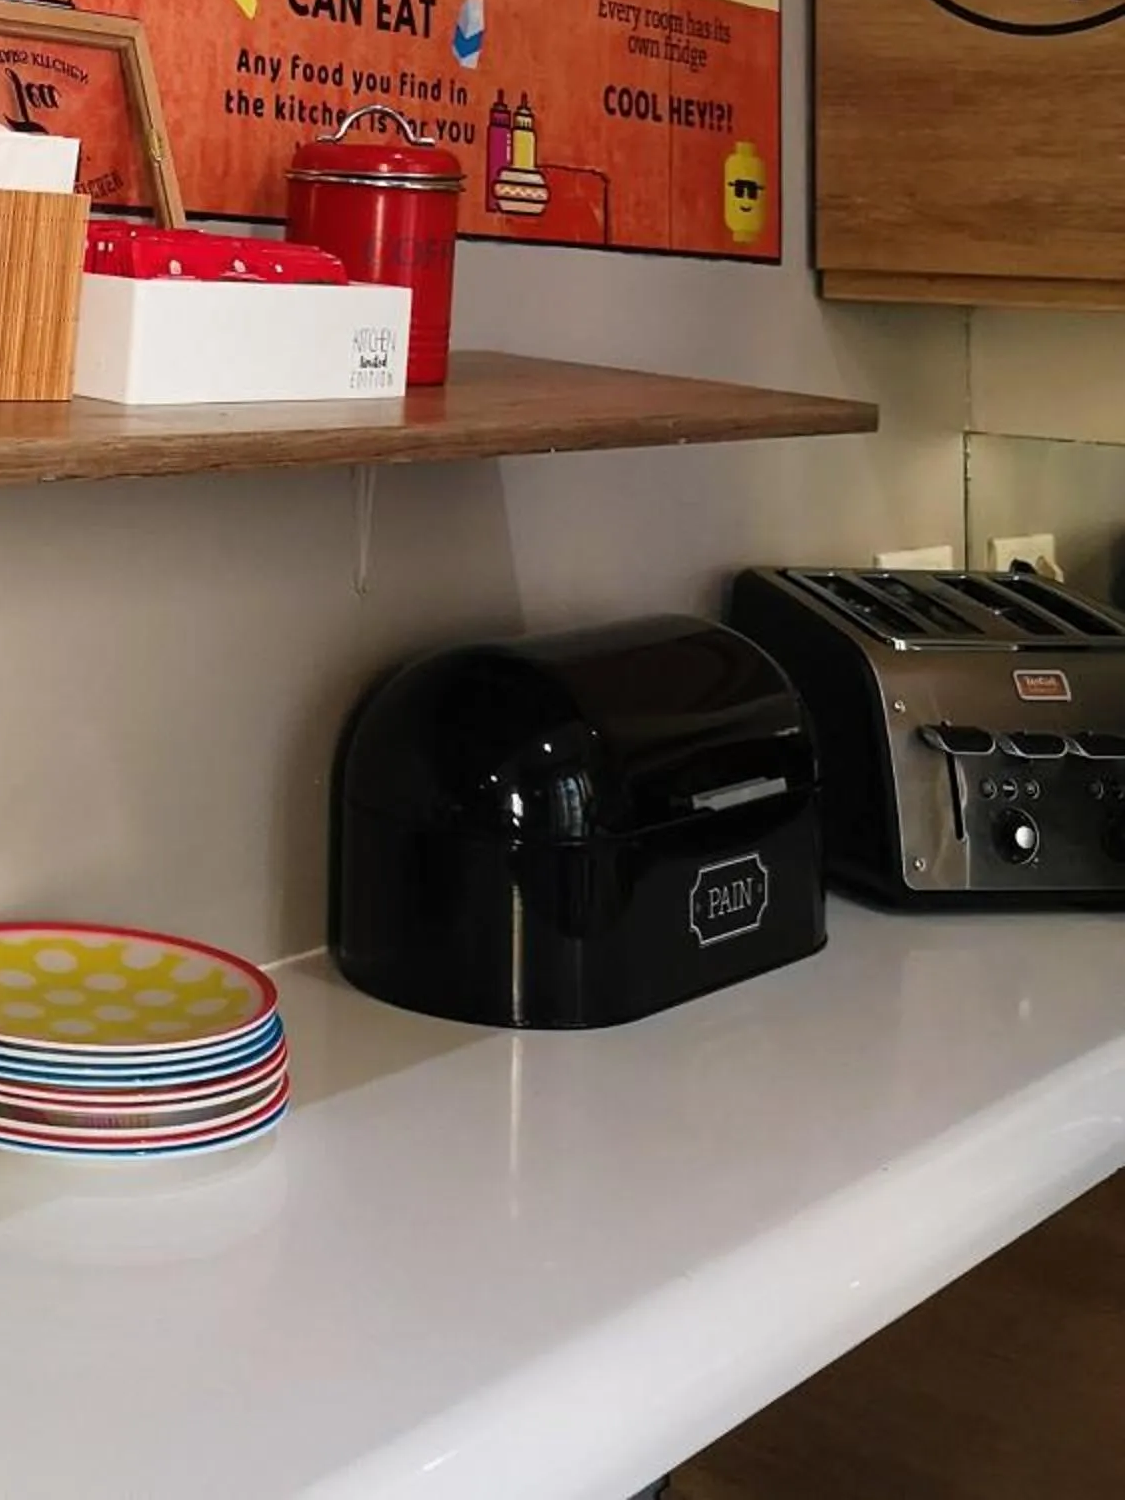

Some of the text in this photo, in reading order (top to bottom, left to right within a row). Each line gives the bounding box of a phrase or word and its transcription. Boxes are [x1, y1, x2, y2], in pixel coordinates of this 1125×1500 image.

[645, 7, 684, 34] room
[685, 10, 711, 40] has
[713, 15, 732, 45] its
[628, 35, 708, 73] own fridge
[237, 49, 468, 106] Any food you find in
[225, 89, 265, 118] the
[370, 109, 388, 133] is
[436, 120, 475, 145] YOU
[603, 84, 734, 135] COOL HEY!?!
[707, 877, 753, 919] PAIN
